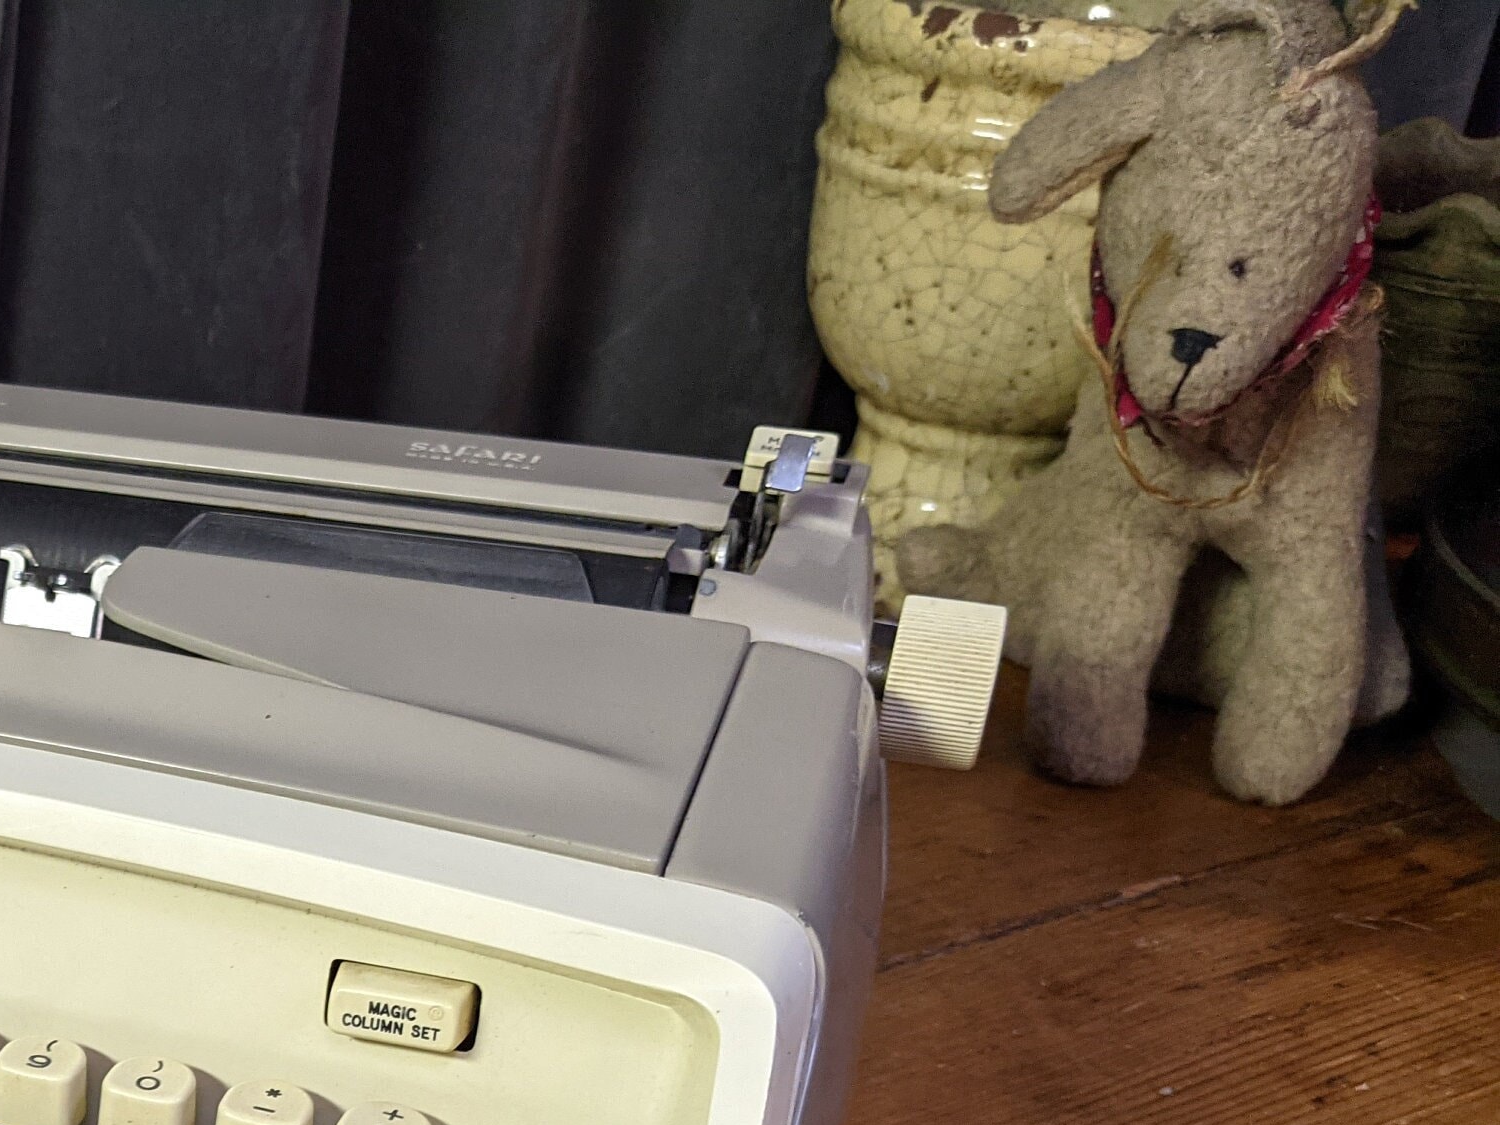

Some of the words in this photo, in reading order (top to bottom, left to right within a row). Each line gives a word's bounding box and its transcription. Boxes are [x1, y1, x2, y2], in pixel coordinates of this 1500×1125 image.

[409, 441, 542, 465] SAFARI
[368, 1001, 417, 1021] MAGIC
[342, 1013, 403, 1035] COLUMN
[411, 1024, 441, 1042] SET
[46, 1039, 58, 1052] (
[26, 1054, 52, 1069] 9
[152, 1060, 164, 1073] )
[382, 1109, 405, 1121] +
